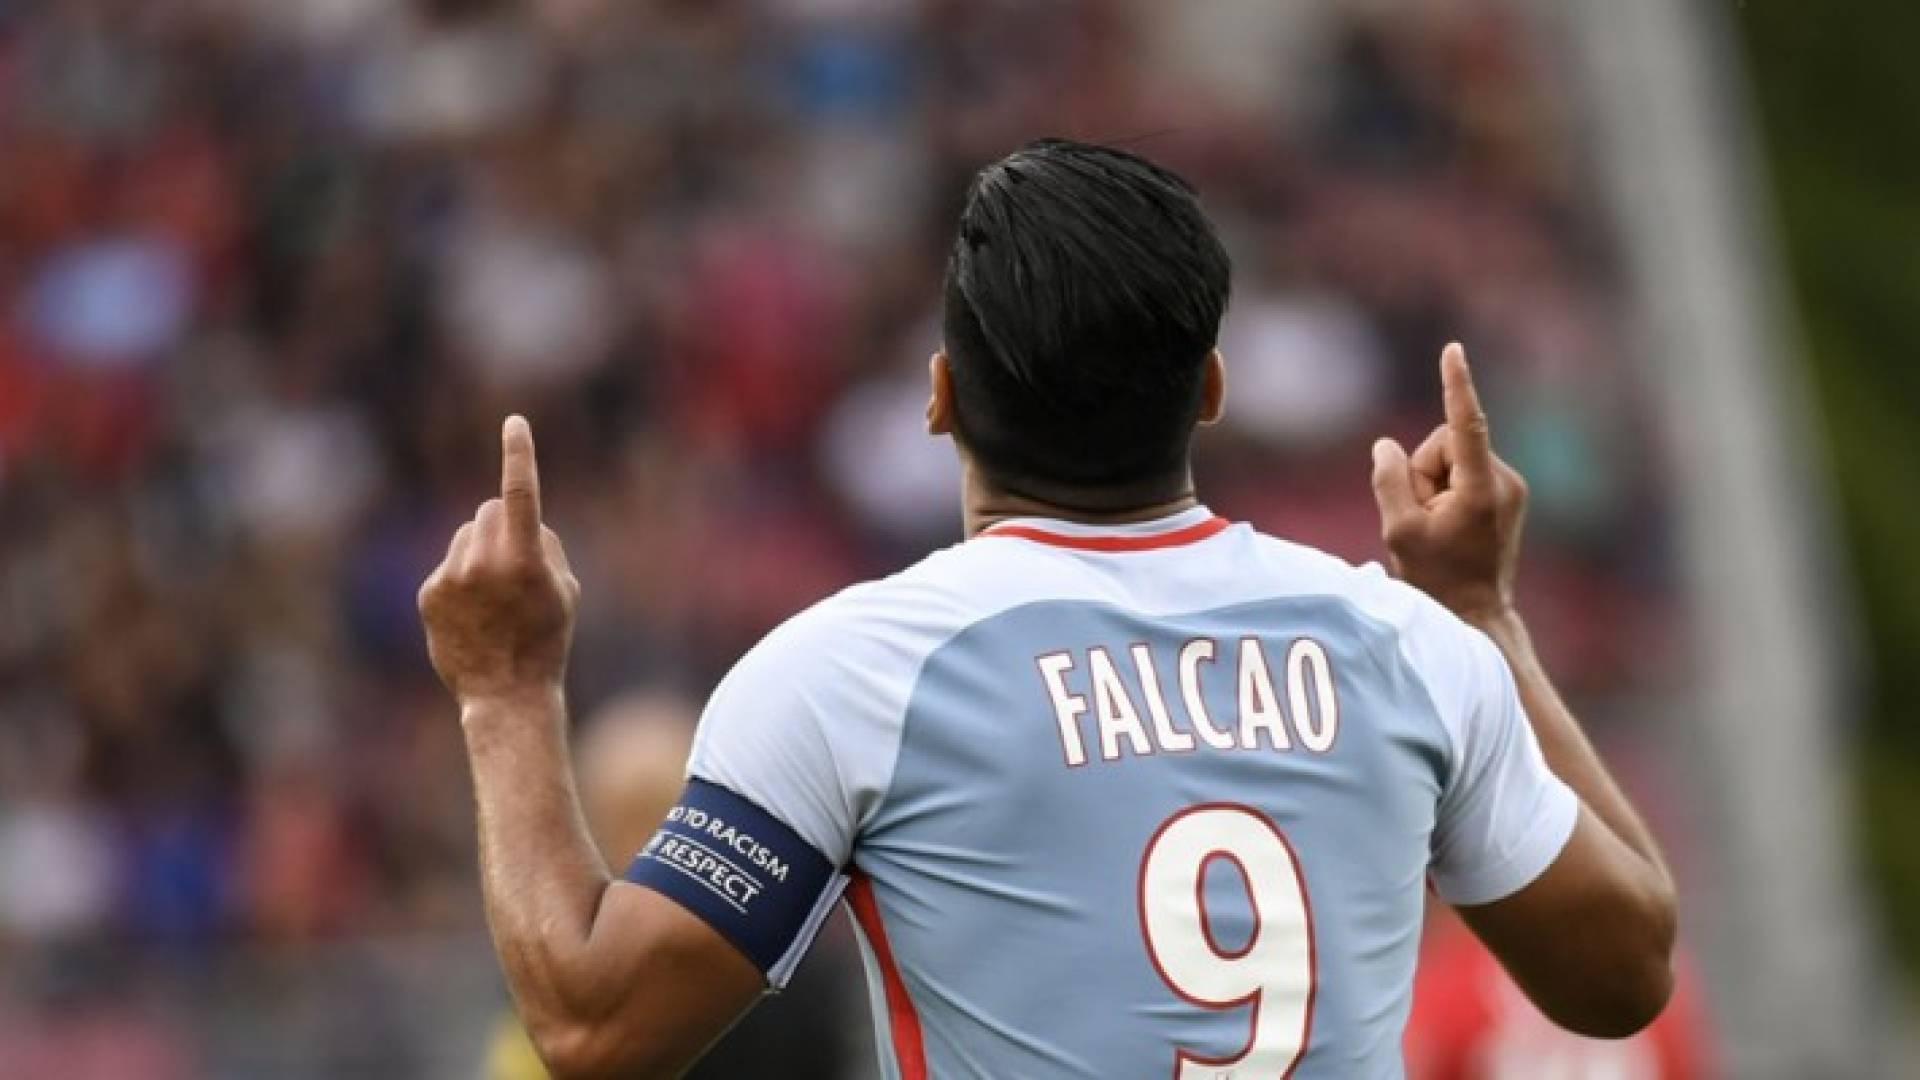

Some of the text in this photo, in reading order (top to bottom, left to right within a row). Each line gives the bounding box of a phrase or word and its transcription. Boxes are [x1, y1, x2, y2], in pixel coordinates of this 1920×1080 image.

[1034, 635, 1339, 767] FALCAO
[661, 839, 760, 902] RESPECT
[683, 807, 708, 829] TO
[706, 818, 789, 881] RACISM
[1138, 802, 1317, 1080] 9
